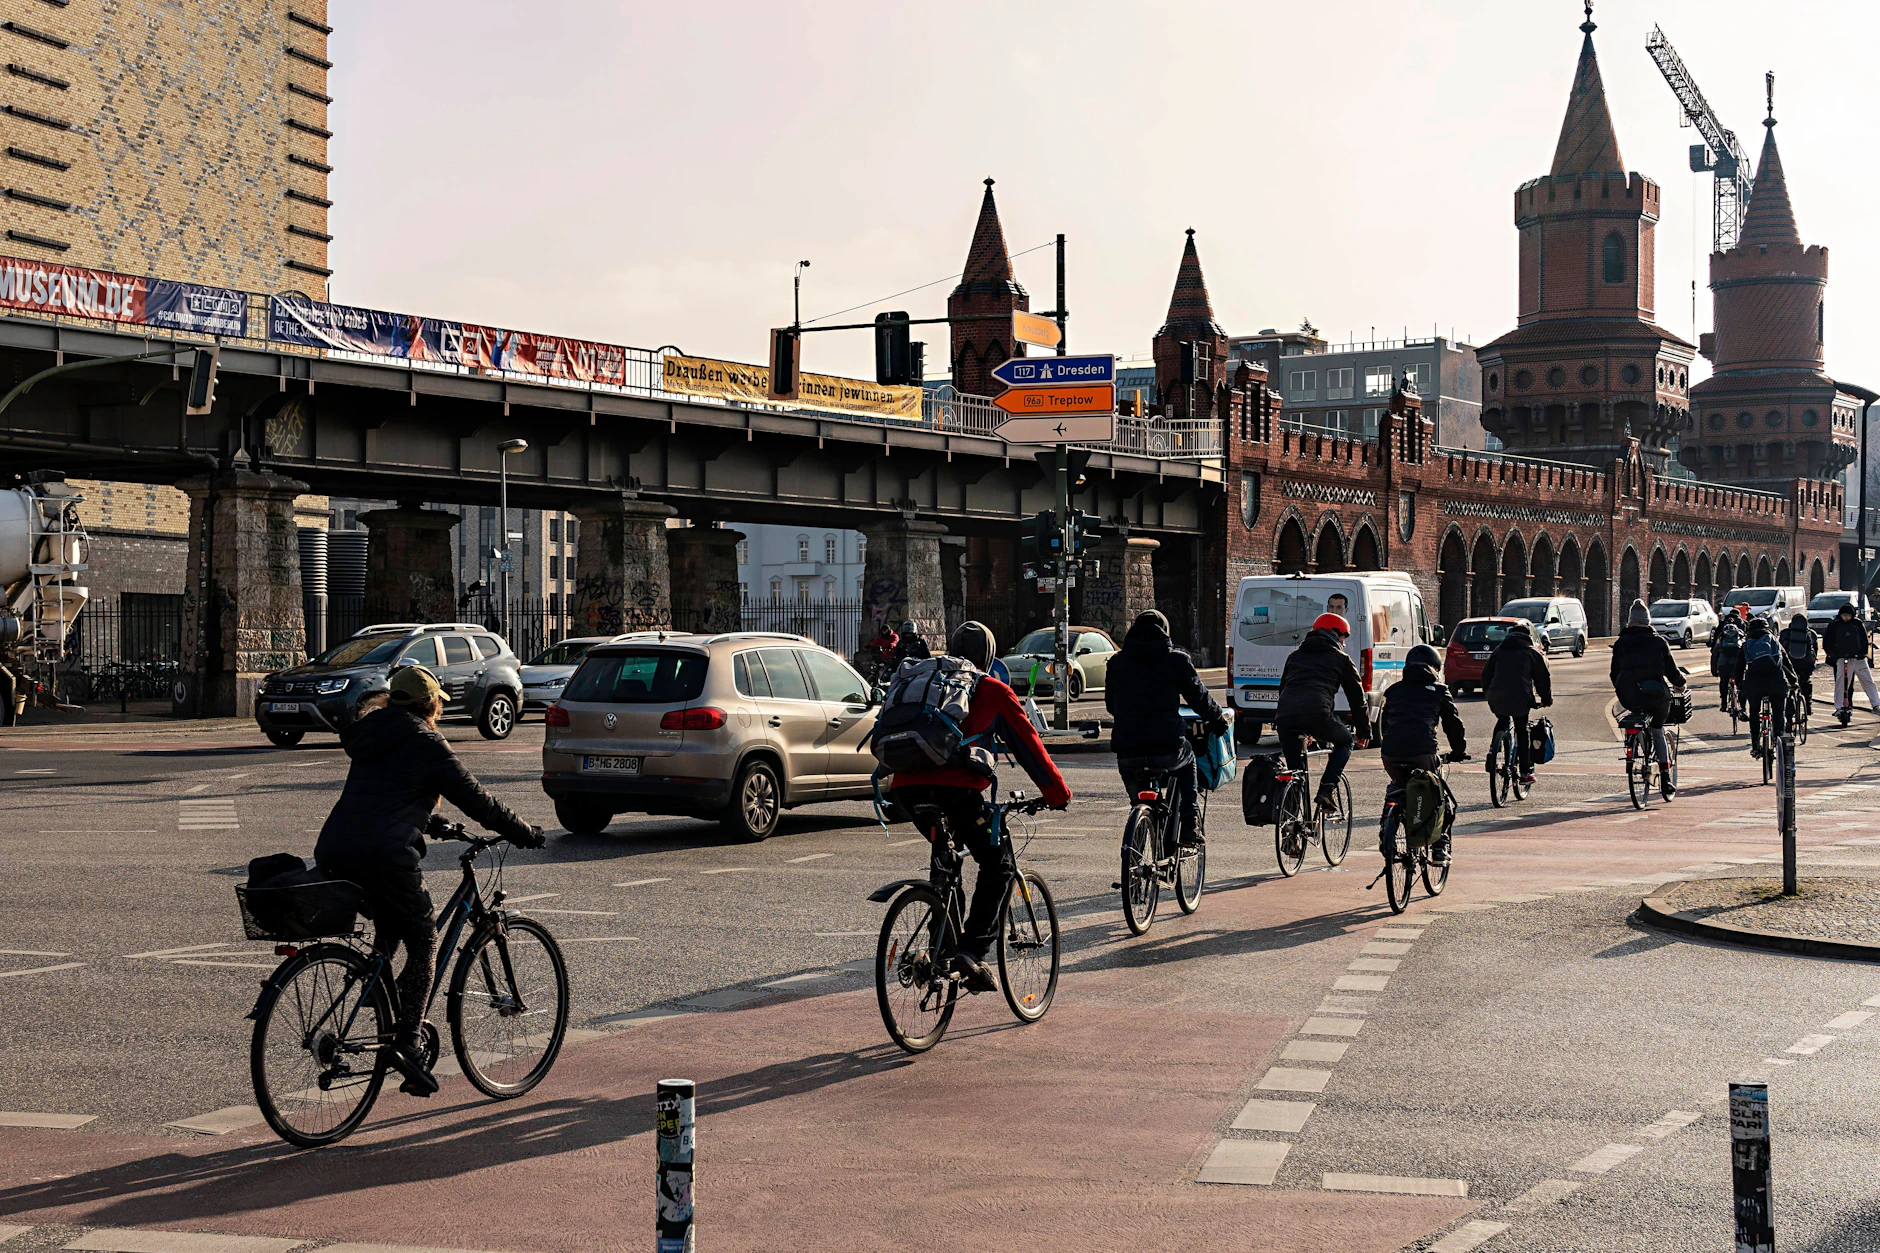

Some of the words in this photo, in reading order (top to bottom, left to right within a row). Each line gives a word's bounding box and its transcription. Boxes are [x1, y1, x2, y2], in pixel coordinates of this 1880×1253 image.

[0, 264, 134, 316] MUSEUM.DE
[158, 310, 241, 331] #COLDWARMUSEUMBERLIN
[275, 303, 325, 325] EXPERIENCE
[326, 312, 344, 326] TWO
[345, 314, 367, 331] SIDES
[275, 320, 284, 334] OF
[285, 321, 300, 336] THE
[666, 360, 723, 382] Draußen
[729, 371, 767, 388] werbe
[1018, 367, 1031, 376] 117
[1057, 363, 1105, 376] Dresden
[1026, 396, 1041, 405] 96a
[1048, 394, 1094, 407] Treptow
[588, 757, 595, 768] B
[600, 758, 612, 769] HG
[613, 758, 637, 770] 2808
